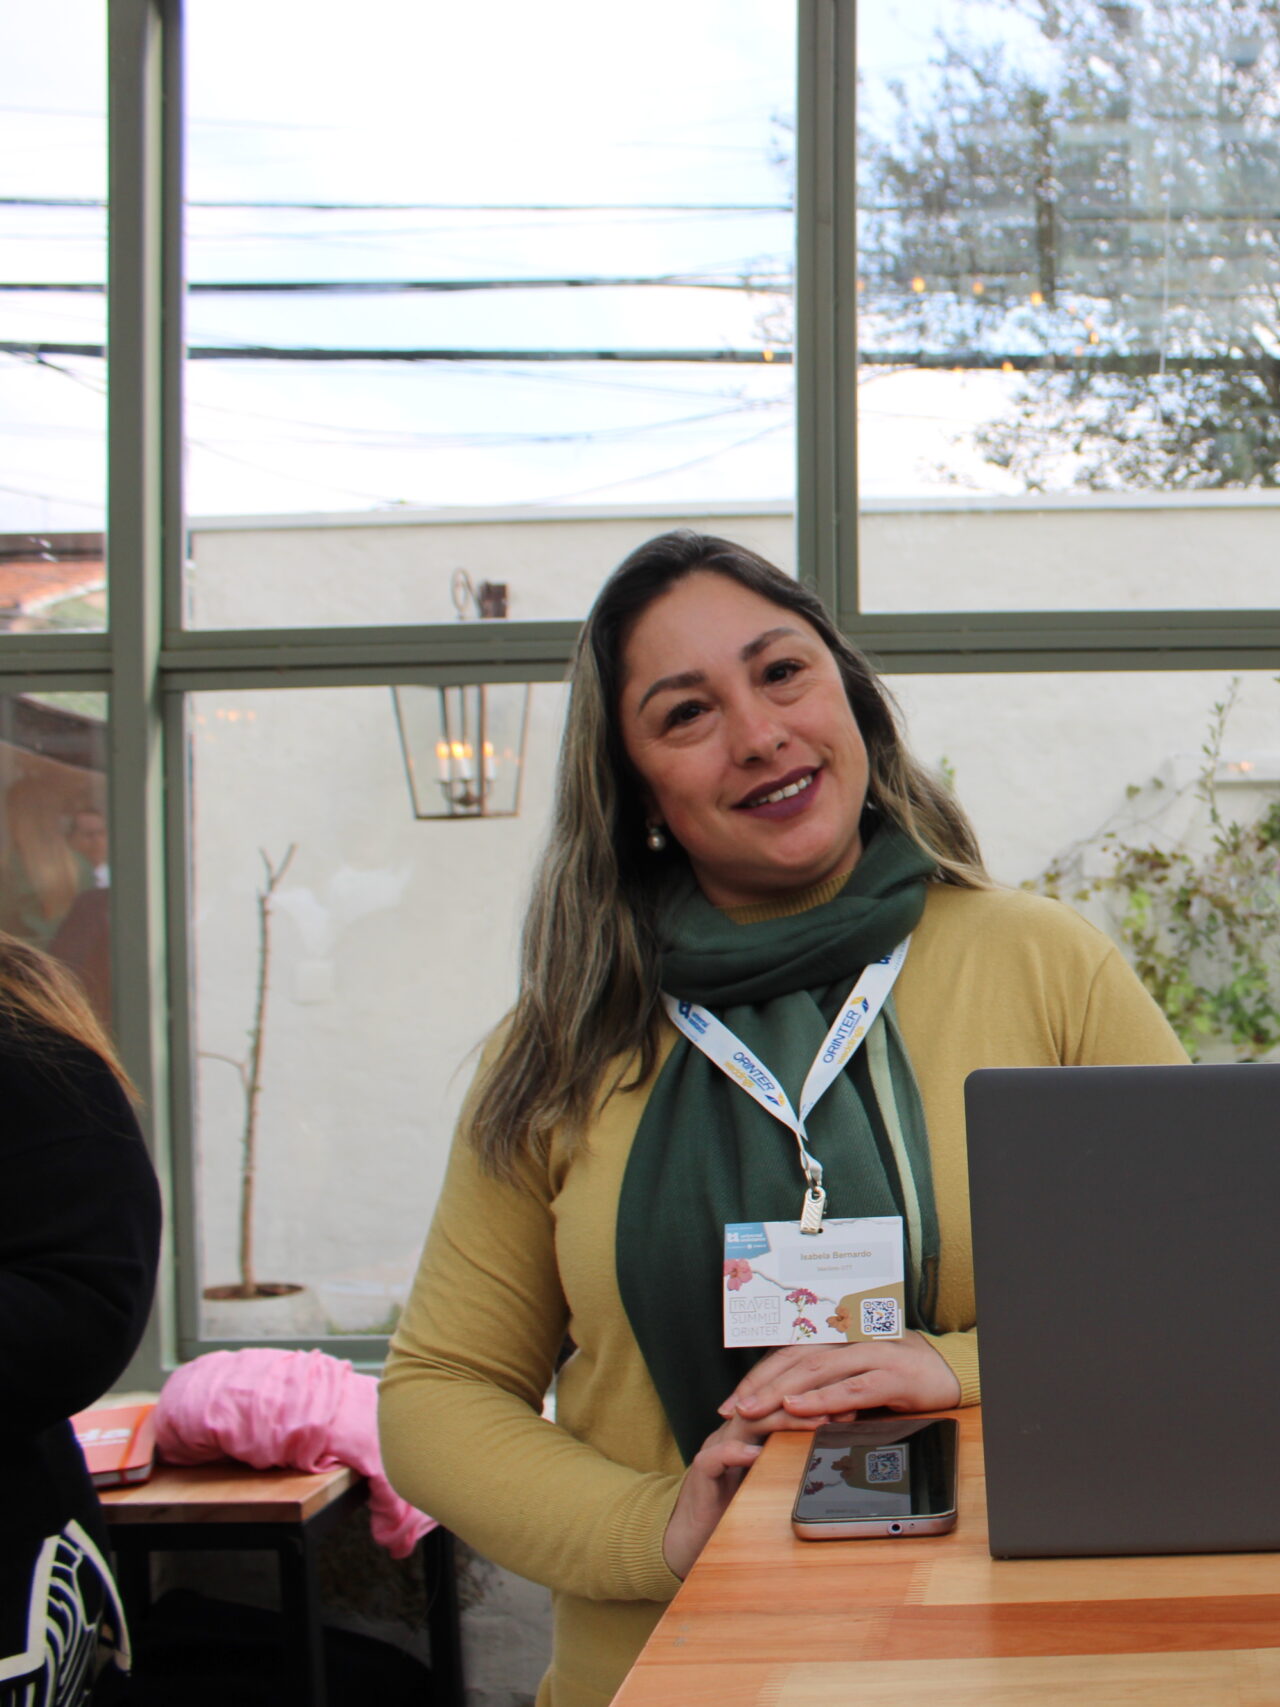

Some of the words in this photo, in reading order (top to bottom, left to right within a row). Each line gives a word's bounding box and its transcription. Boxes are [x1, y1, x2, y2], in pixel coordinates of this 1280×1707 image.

[823, 1009, 859, 1064] ORINTER
[732, 1051, 775, 1091] ORINTER
[801, 1251, 831, 1261] Isabela
[832, 1250, 872, 1260] Bernardo
[733, 1298, 778, 1310] TRAVEL
[732, 1312, 778, 1324] SUMMIT
